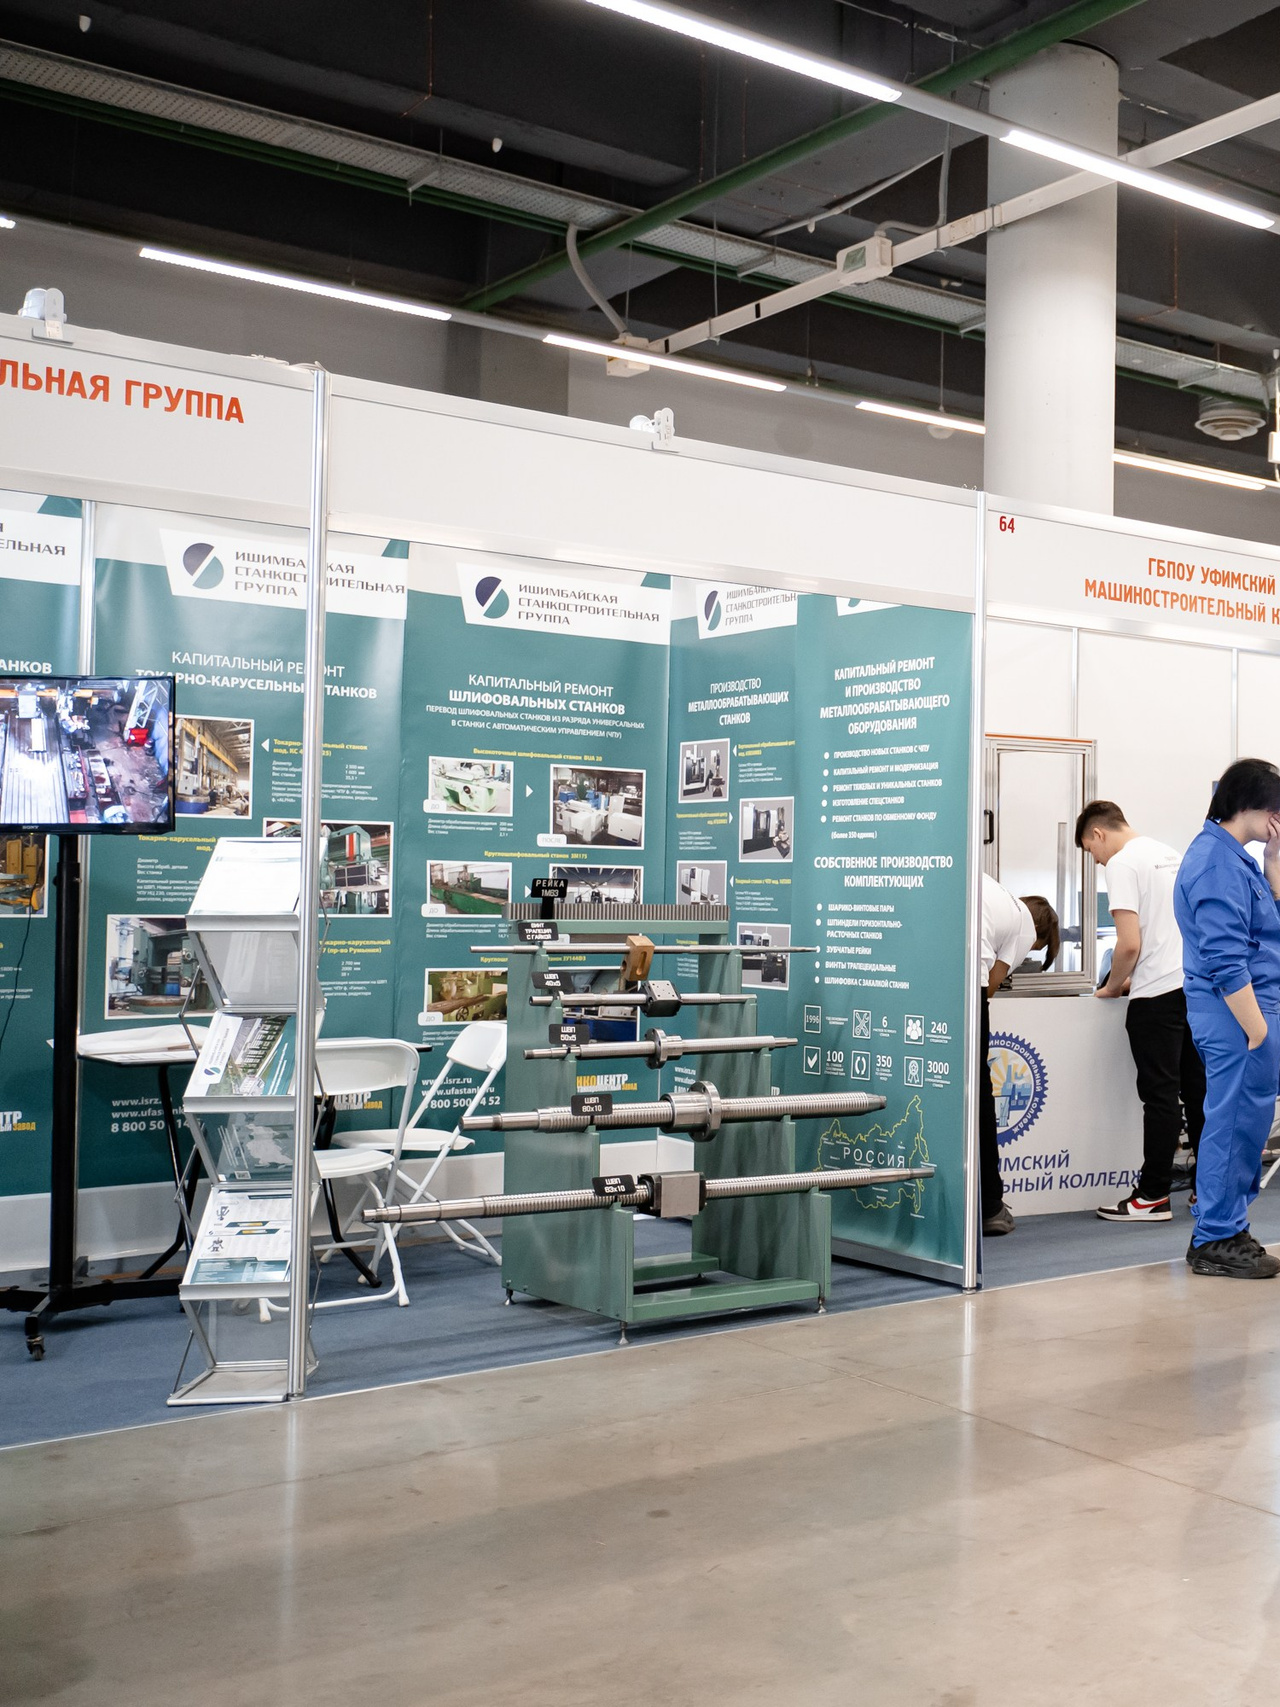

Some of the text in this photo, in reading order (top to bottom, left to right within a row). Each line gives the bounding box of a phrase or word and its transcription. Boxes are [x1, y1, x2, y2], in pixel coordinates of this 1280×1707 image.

[125, 380, 244, 424] ГРУППА
[999, 515, 1016, 534] 64
[235, 551, 355, 575] ИШИМБАКАЯ
[235, 566, 406, 594] СТАНКОСТИТЕЛЬНАЯ
[1148, 557, 1276, 596] ГБПОУ УФИМСКИЙ
[235, 581, 298, 597] ГРУППА
[519, 583, 618, 604] ИШИМБАЙСКАЯ
[1084, 578, 1266, 624] МАШИНОСТРОИТЕЛЬНЫЙ
[518, 597, 660, 622] СТАНКОСТРОИТЕЛЬНАЯ
[518, 610, 571, 625] ГРУППА
[725, 614, 754, 626] ГРУППА
[172, 651, 345, 678] КАПИТАЛЬНЫЙ РЕНТ
[834, 656, 935, 681] КАПИТАЛЬНЫЙ РЕМОНТ
[135, 669, 378, 700] ТОКАРНО-КАРУСЕЛЬНЫ ТАНКОВ
[468, 674, 614, 698] КАПИТАЛЬНЫЙ РЕМОНТ
[710, 677, 762, 694] ПРОИЗВОДСТВО
[845, 677, 921, 698] И ПРОИЗВОДСТВО
[449, 689, 626, 716] ШЛИФОВАЛЬНЫХ СТАНКОВ
[688, 691, 790, 713] МЕТАЛЛООБРАБАТЫВАЮЩИХ
[820, 694, 950, 719] МЕТАЛЛООБРАБАТЫВАЮЩЕГО
[426, 705, 645, 730] ПЕРЕВОД ШЛИФОВАЛЬНЫХ СТАНКОВ ИЗ РАЗРЯДА УНИВЕРСАЛЬНЫХ
[719, 712, 751, 726] СТАНКОВ
[451, 719, 456, 727] В
[457, 719, 486, 729] СТАНКИ
[492, 722, 557, 735] АВТОМАТИЧЕСКИМ
[558, 726, 606, 738] УПРАВЛЕНИЕМ
[606, 729, 622, 740] (ЧПУ)
[848, 716, 917, 735] ОБОРУДОВАНИЯ
[833, 744, 930, 759] ПРОИЗВОДСТВО НОВЫХ СТАНКОВ ЧПУ
[833, 761, 939, 776] КАПИТАЛЬНЫЙ РЕМОНТ МОДЕРНИЗАЦИЯ
[833, 783, 852, 792] РЕМОНТ
[881, 780, 916, 790] УНИКАЛЬНЫХ
[917, 778, 943, 788] СТАНКОВ
[832, 814, 852, 823] РЕМОНТ
[853, 813, 874, 822] СТАНКОВ
[874, 813, 882, 821] ПО
[916, 811, 937, 821] ФОНДУ
[814, 855, 953, 870] СОБСТВЕННОЕ ПРОИЗВОДСТВО
[535, 879, 565, 889] РЕЙКА
[844, 875, 924, 890] КОМПЛЕКТУЮЩИХ
[828, 903, 895, 912] ШАРИКО-ВИНТОВЫЕ ПАРЫ
[827, 918, 859, 928] ШПИНДЕЛИ
[826, 930, 883, 940] РАСТОЧНЫХ СТАНКОВ
[826, 945, 872, 955] ЗУБЧАТЫЕ РЕЙКИ
[825, 961, 846, 969] ВИНТЫ
[824, 976, 858, 986] ШЛИФОВКА
[882, 1016, 888, 1028] 6
[930, 1021, 948, 1034] 240
[560, 1026, 576, 1034] ШВП
[826, 1050, 844, 1063] 100
[876, 1055, 892, 1068] 350
[927, 1060, 950, 1075] 3000
[112, 1097, 162, 1107] www.isrz.
[430, 1099, 451, 1109] 800
[488, 1096, 500, 1106] 52
[585, 1096, 600, 1104] ШВП
[111, 1122, 119, 1133] 8
[122, 1121, 147, 1132] 800
[149, 1120, 165, 1131] 50
[843, 1147, 905, 1168] РОССИЯ
[605, 1177, 621, 1186] ШВП
